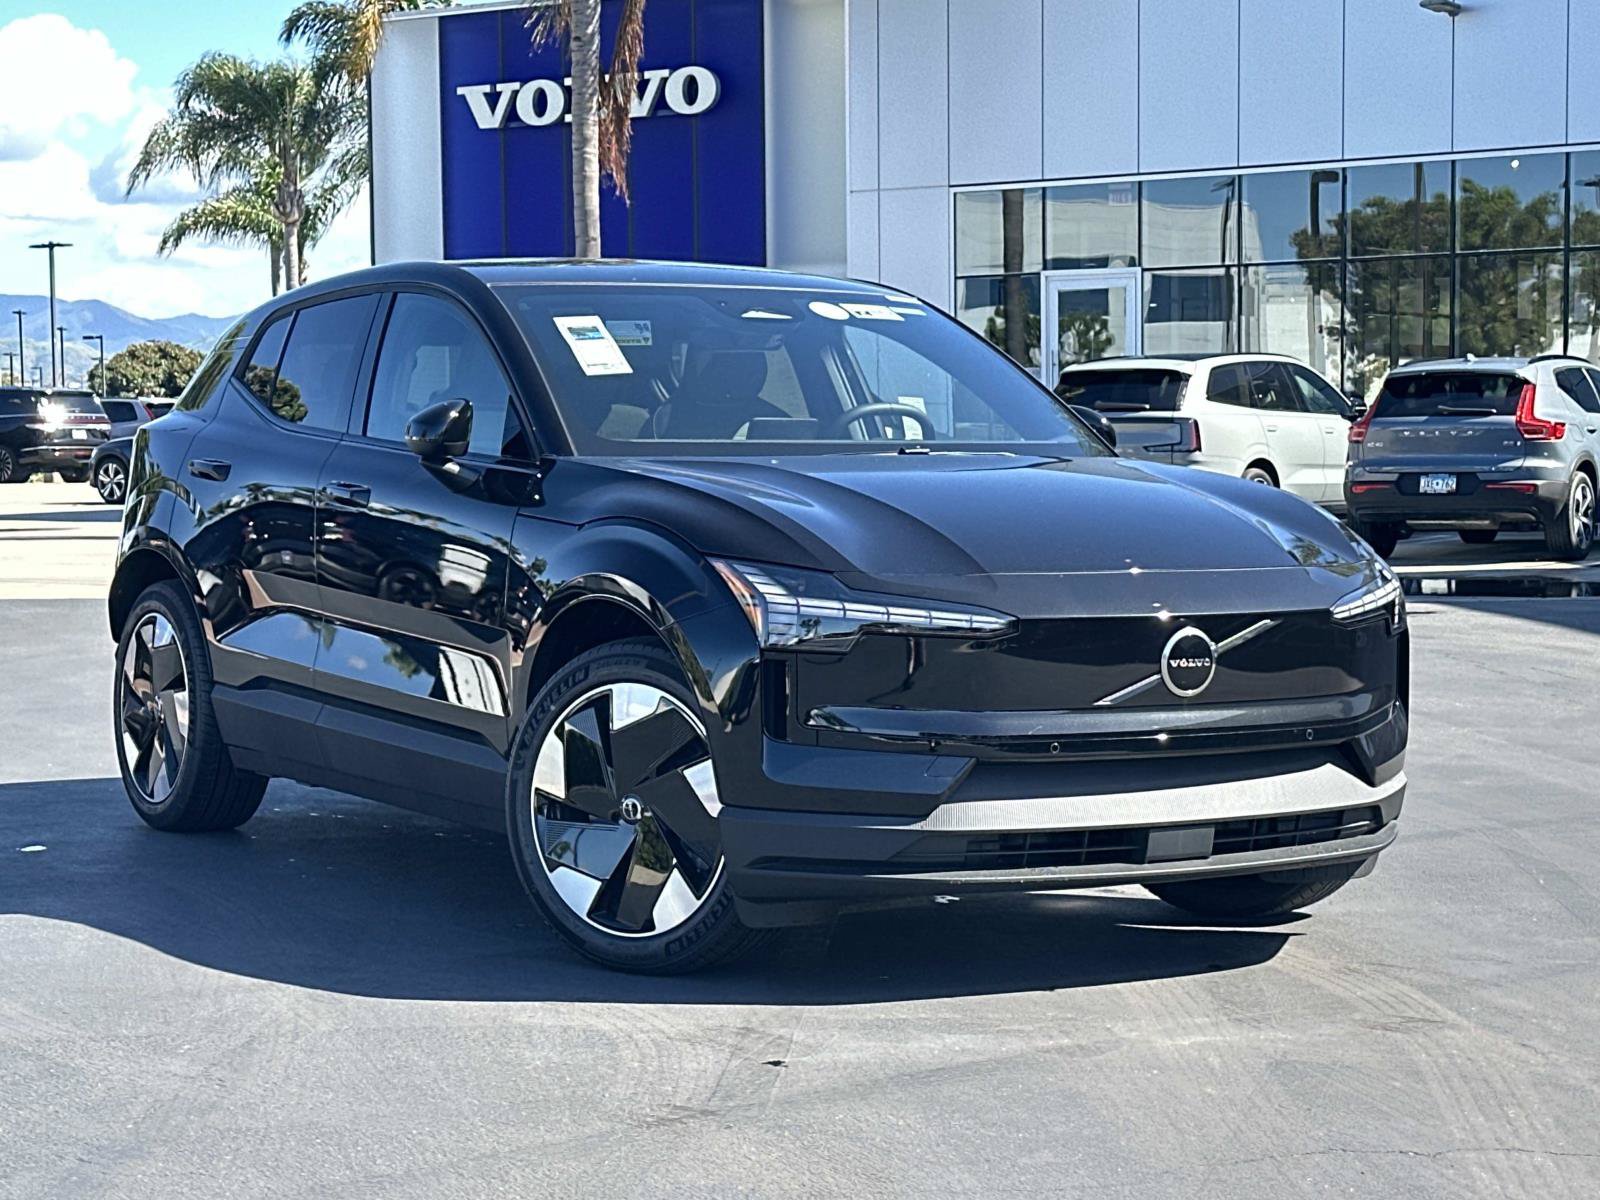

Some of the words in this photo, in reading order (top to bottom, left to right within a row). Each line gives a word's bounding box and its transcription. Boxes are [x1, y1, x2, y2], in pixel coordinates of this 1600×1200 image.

[456, 66, 718, 129] VOVO
[1169, 658, 1211, 668] VOLVO
[522, 668, 587, 745] MICHELIN
